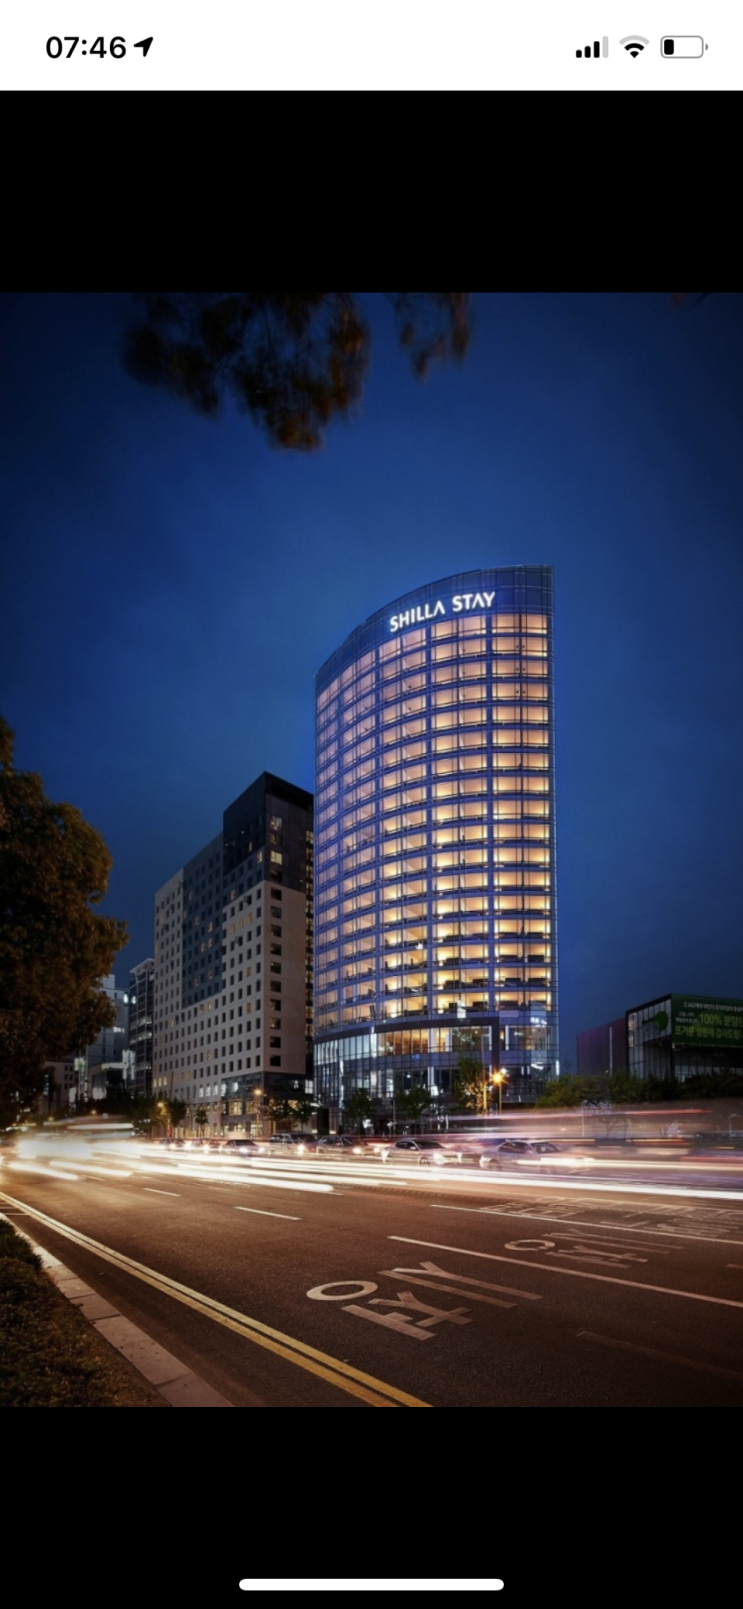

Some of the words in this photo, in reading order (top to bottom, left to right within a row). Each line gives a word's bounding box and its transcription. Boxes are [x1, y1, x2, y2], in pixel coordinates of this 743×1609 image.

[389, 600, 446, 632] SHILLA
[452, 591, 496, 612] STAY
[699, 1012, 723, 1026] 100%
[306, 1261, 543, 1341] 시청
